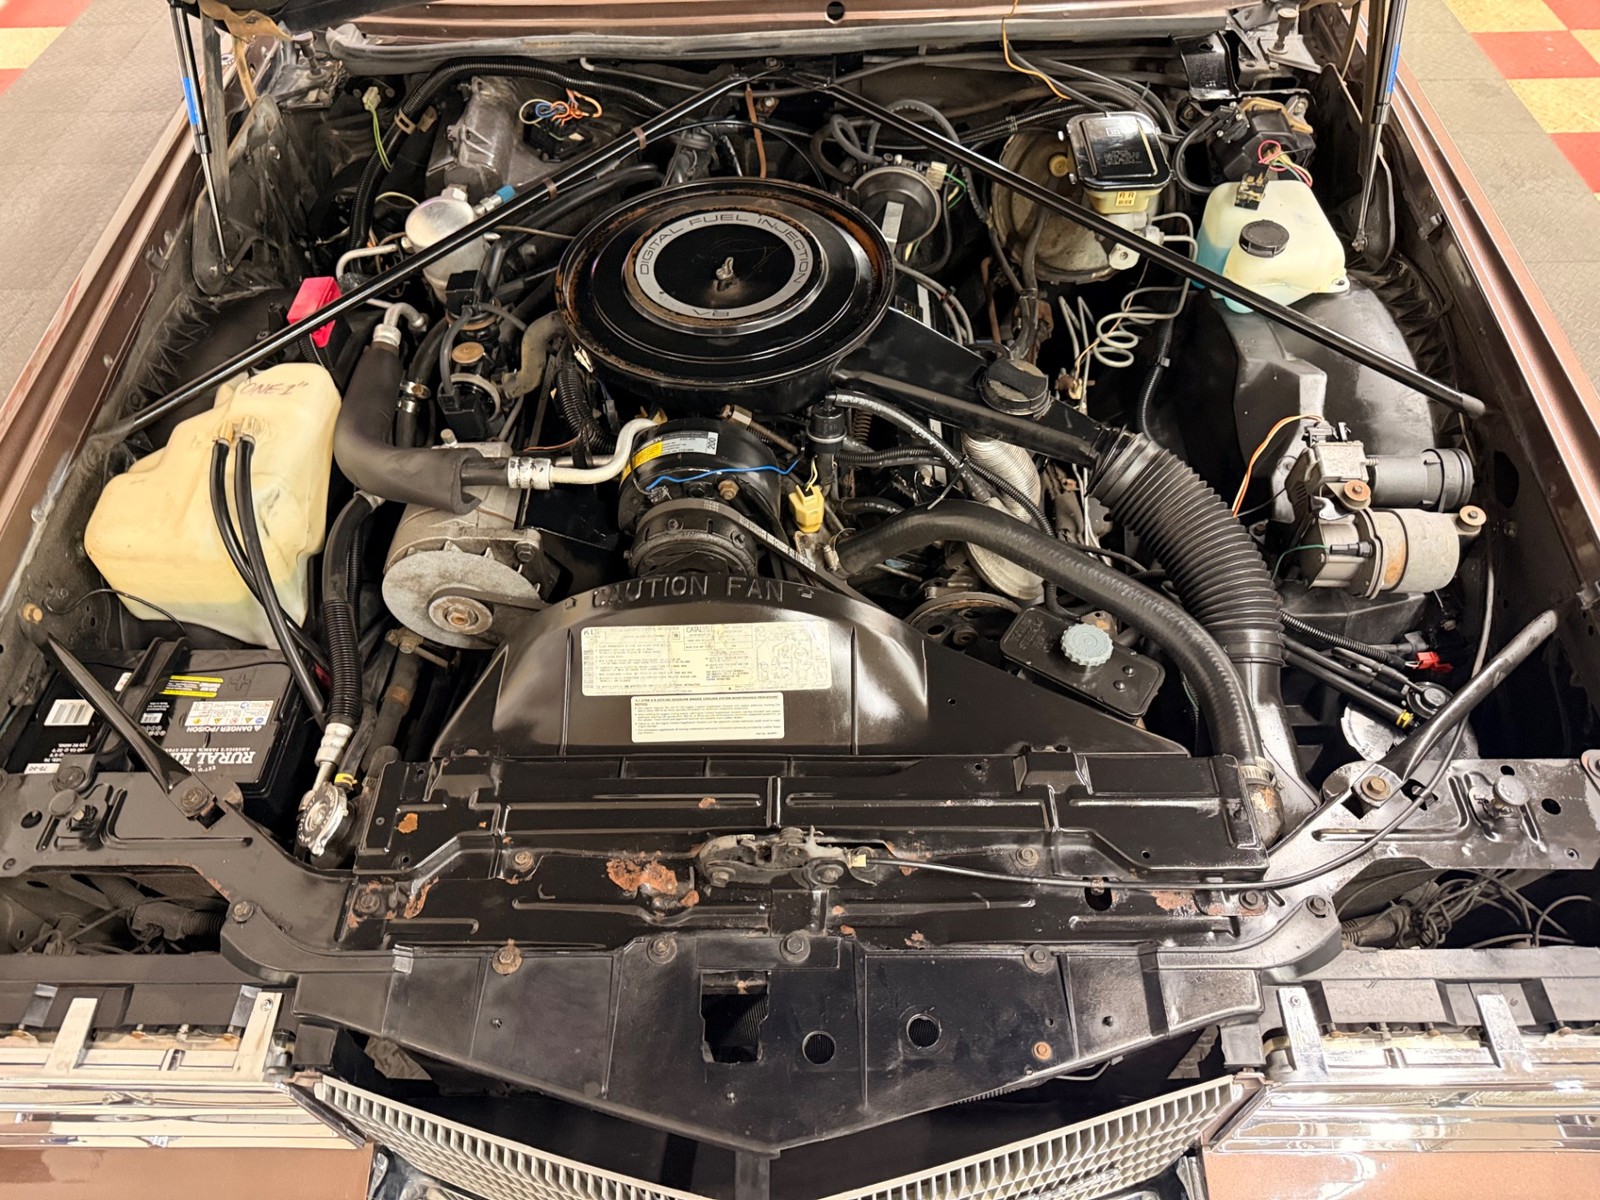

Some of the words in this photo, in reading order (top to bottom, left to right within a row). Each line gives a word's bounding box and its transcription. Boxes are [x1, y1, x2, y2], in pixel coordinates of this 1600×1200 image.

[640, 226, 684, 275] DIGITAL
[689, 213, 749, 227] FUEL
[757, 216, 808, 284] INJECTION
[693, 309, 730, 318] V8
[707, 437, 717, 450] 200
[592, 576, 709, 608] CAUTION
[726, 576, 784, 602] FAN
[196, 751, 256, 765] RURAL
